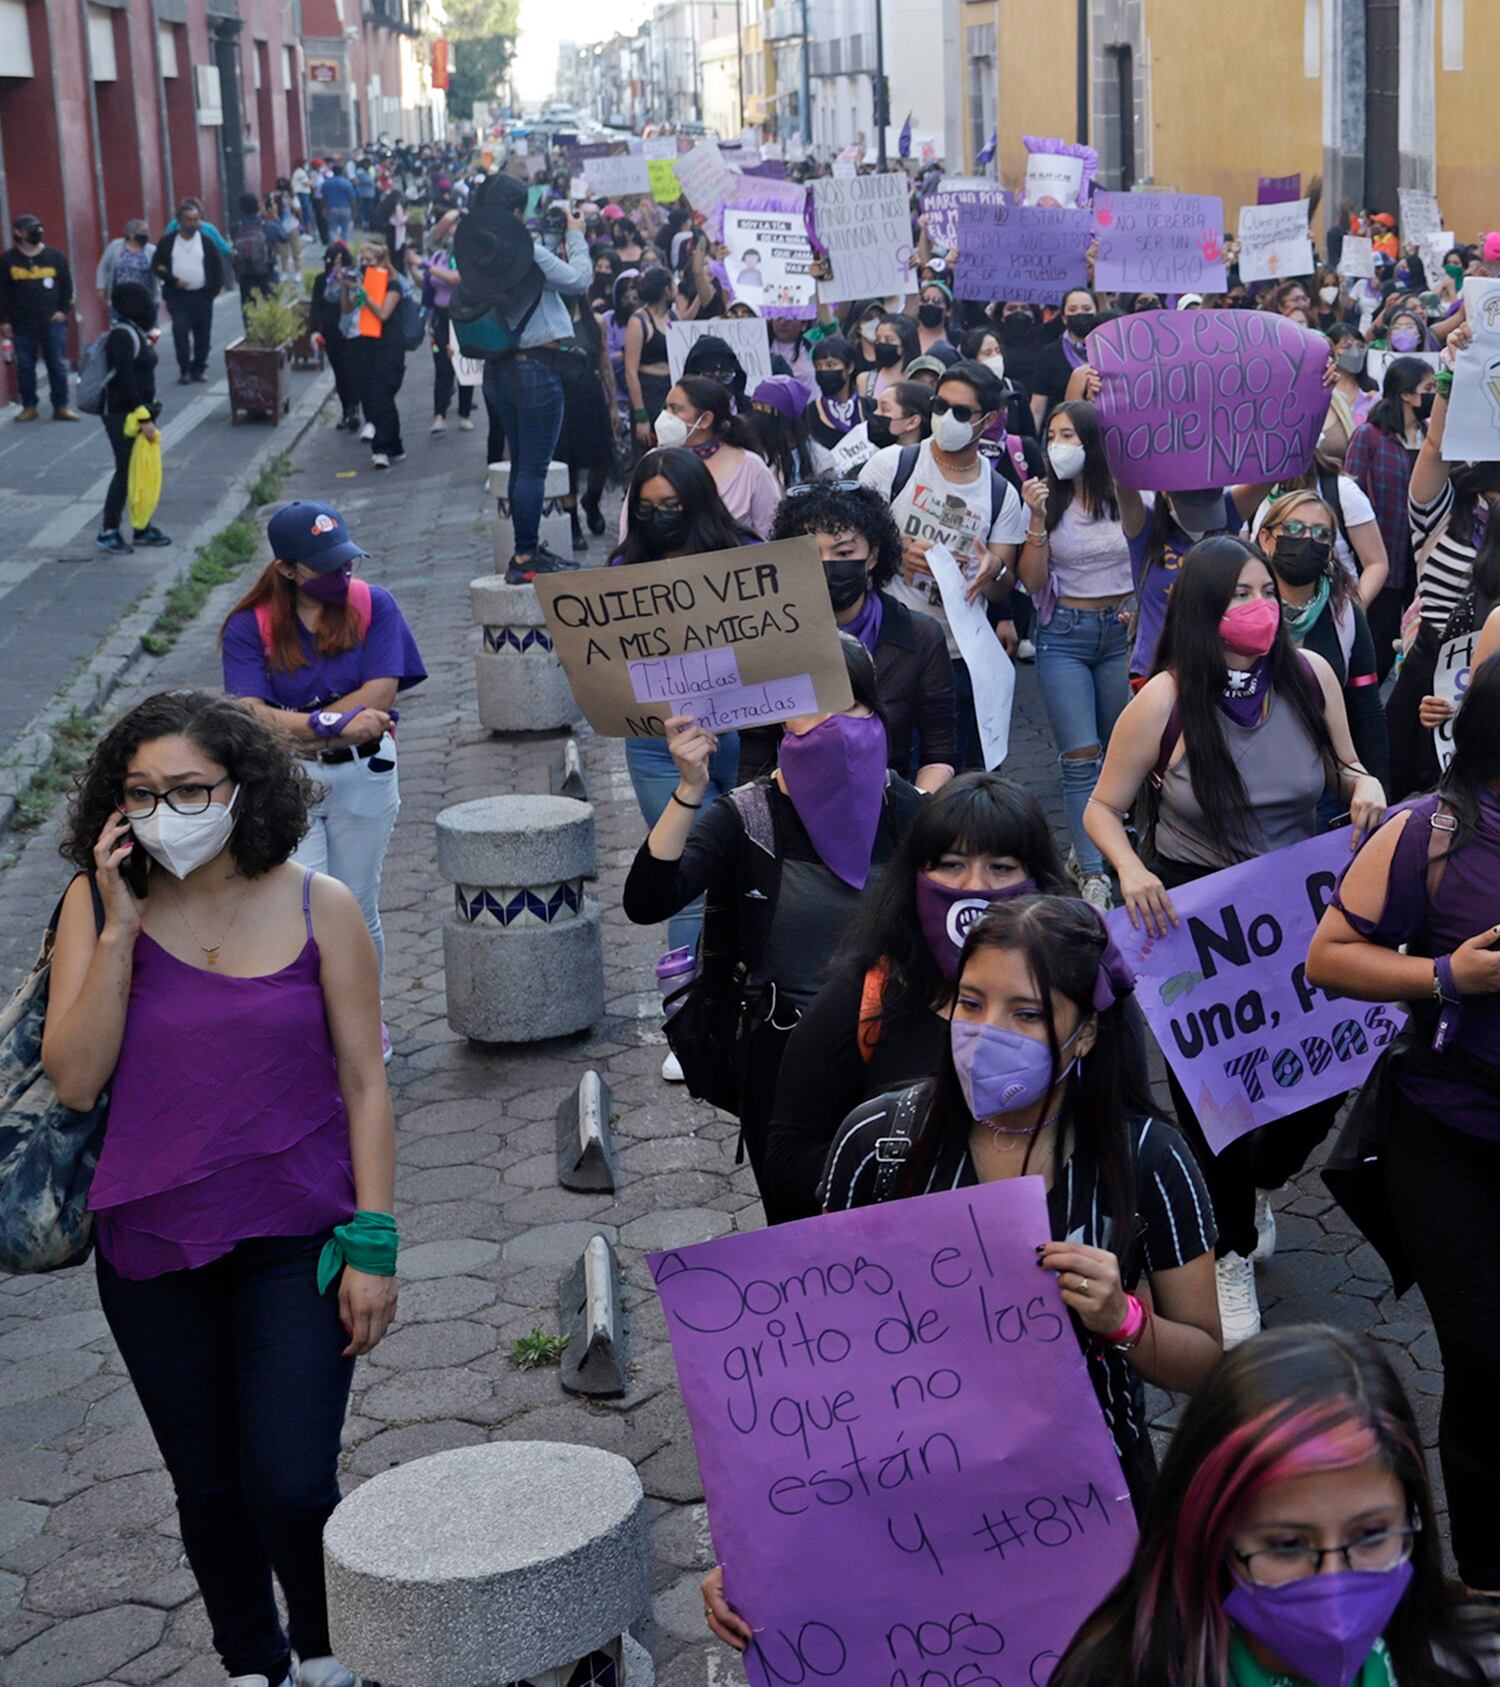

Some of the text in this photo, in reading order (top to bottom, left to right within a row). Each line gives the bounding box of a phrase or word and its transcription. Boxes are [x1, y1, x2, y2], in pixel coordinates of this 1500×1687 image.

[1121, 255, 1204, 284] LOGRO
[1093, 312, 1183, 368] Nos
[1099, 349, 1272, 417] matando
[1103, 410, 1210, 464] nadie
[552, 563, 780, 629] QUIERO VER
[585, 603, 800, 665] A MIS AMIGAS
[629, 653, 738, 698] Tituladas
[1187, 904, 1283, 980] No
[1223, 1004, 1398, 1104] TODAS
[655, 1203, 995, 1333] Somos el
[723, 1285, 1065, 1435] grito de las
[769, 1368, 962, 1459] que no
[768, 1425, 962, 1515] están
[972, 1482, 1111, 1561] #8M
